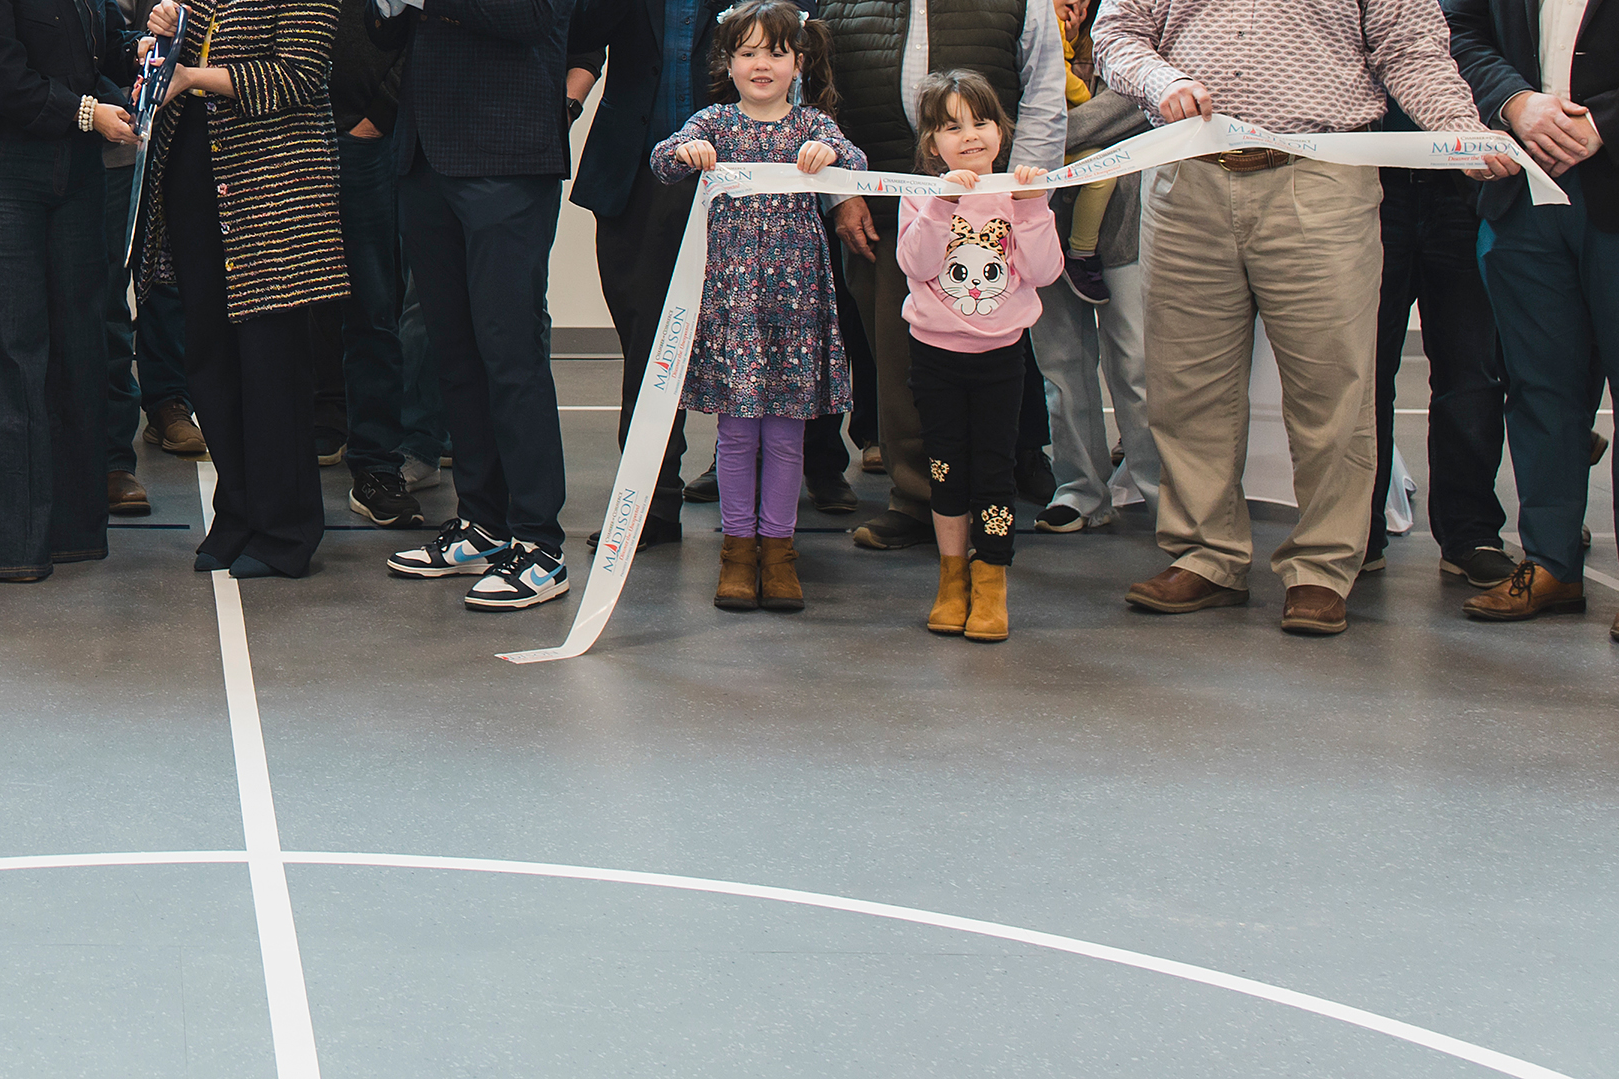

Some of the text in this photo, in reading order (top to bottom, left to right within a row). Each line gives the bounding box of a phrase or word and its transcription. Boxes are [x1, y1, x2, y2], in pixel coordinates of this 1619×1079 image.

[1432, 136, 1520, 156] MADISON
[1046, 150, 1131, 183] MADISON
[857, 177, 941, 194] MADISON
[653, 306, 686, 391] MADISON
[603, 488, 636, 573] MADISON
